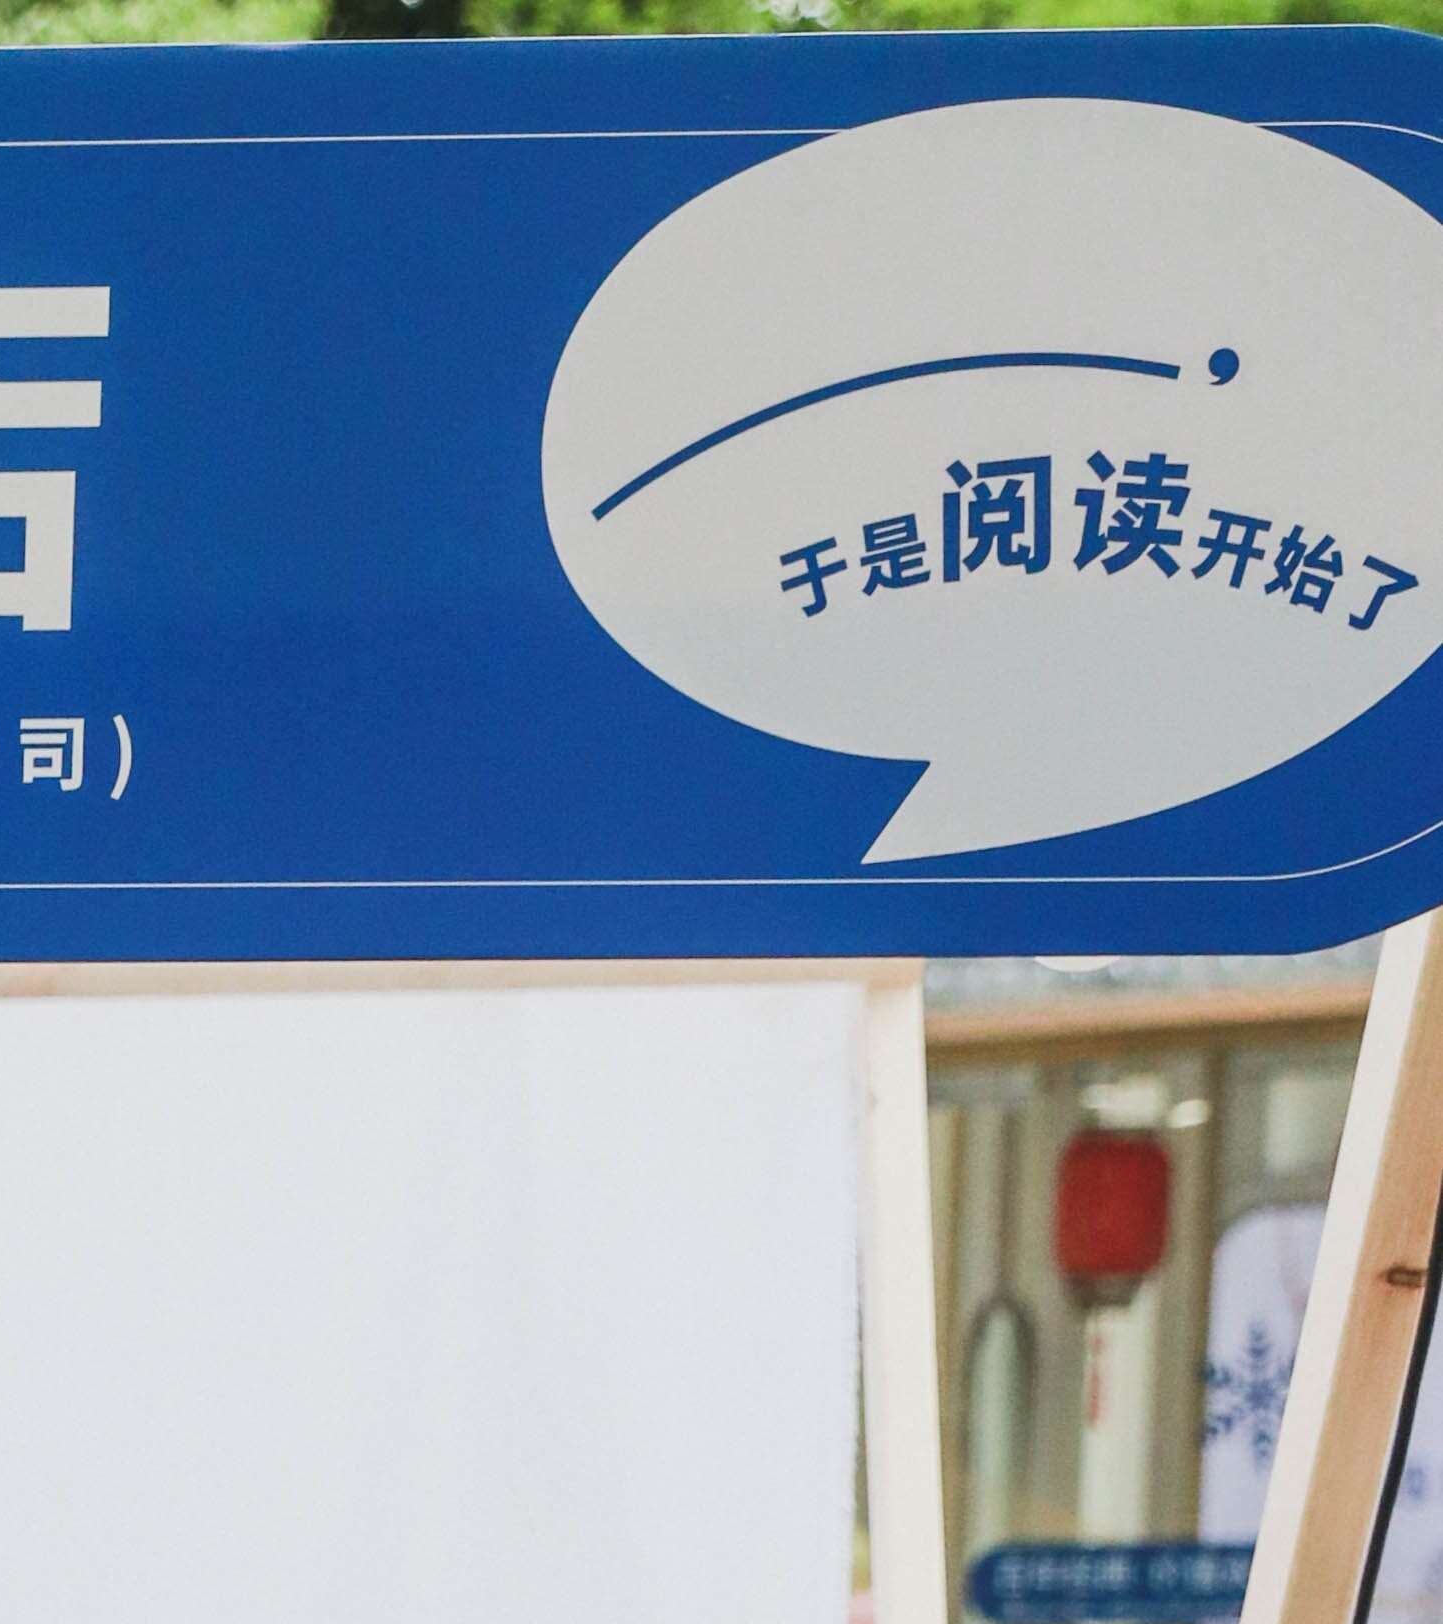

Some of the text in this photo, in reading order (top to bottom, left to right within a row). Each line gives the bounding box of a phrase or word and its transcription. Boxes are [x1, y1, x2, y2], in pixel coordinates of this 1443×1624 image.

[779, 450, 1420, 631] 于是阅读开始了
